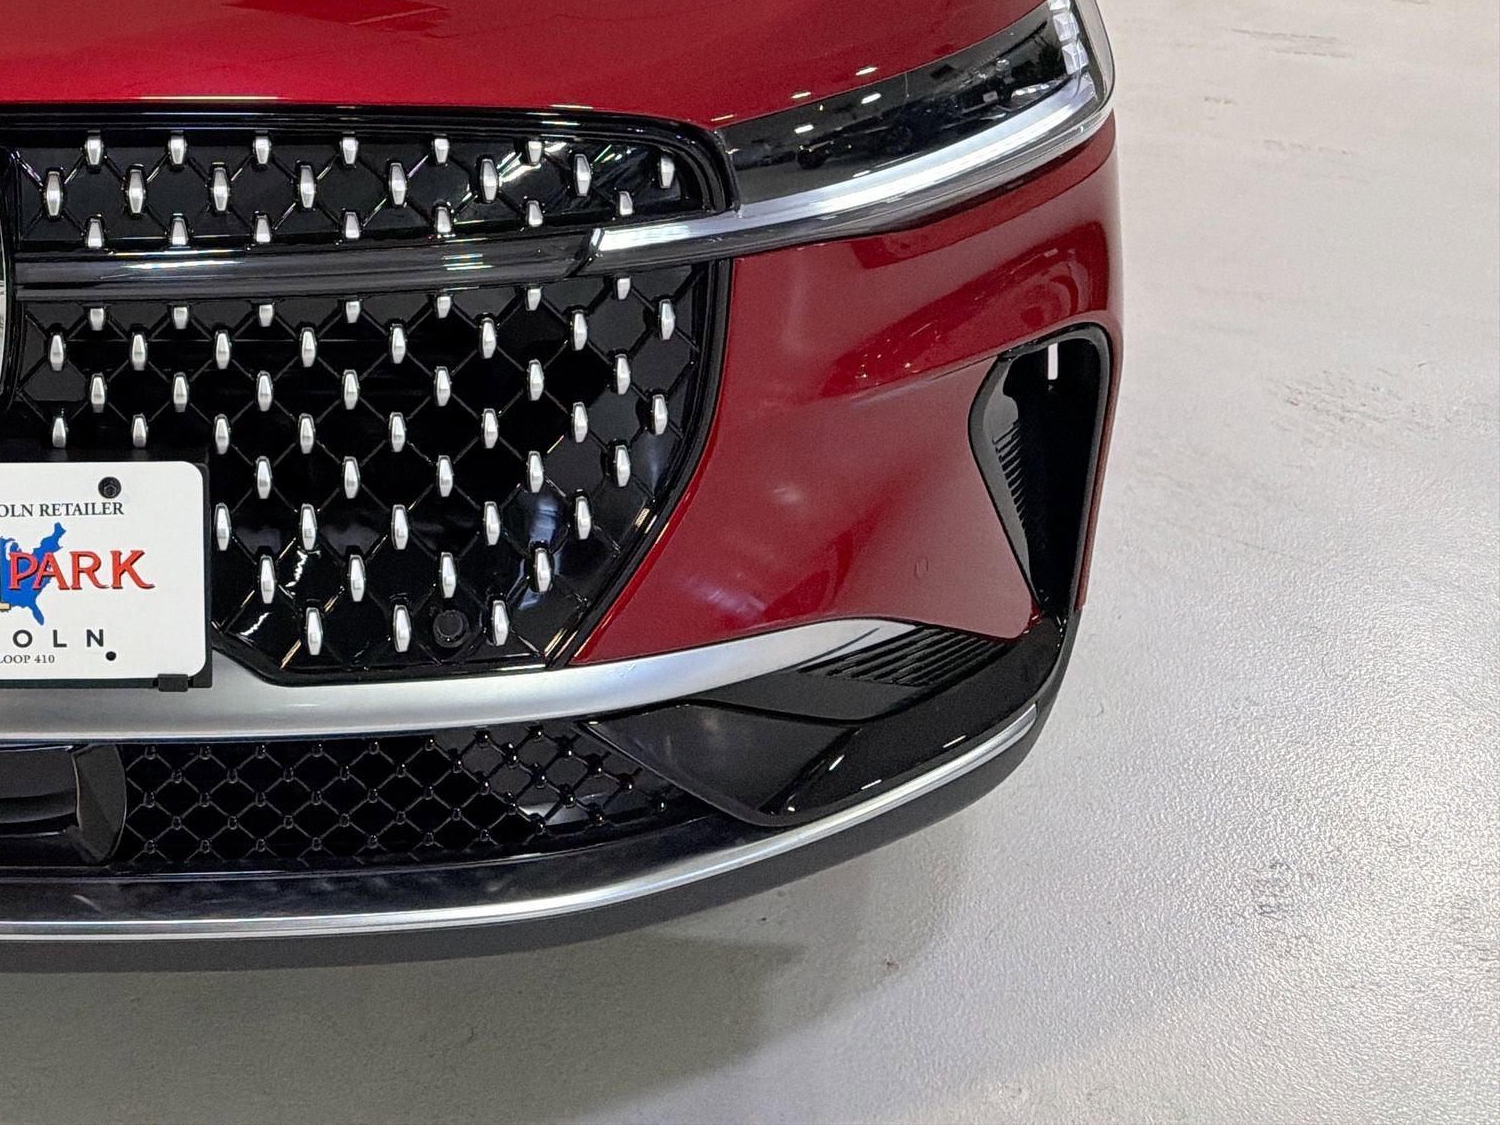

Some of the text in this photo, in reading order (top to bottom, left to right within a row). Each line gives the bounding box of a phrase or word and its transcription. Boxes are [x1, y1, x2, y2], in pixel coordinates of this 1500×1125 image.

[39, 501, 124, 516] RETAILER
[8, 549, 156, 591] PARK
[34, 654, 56, 665] 410
